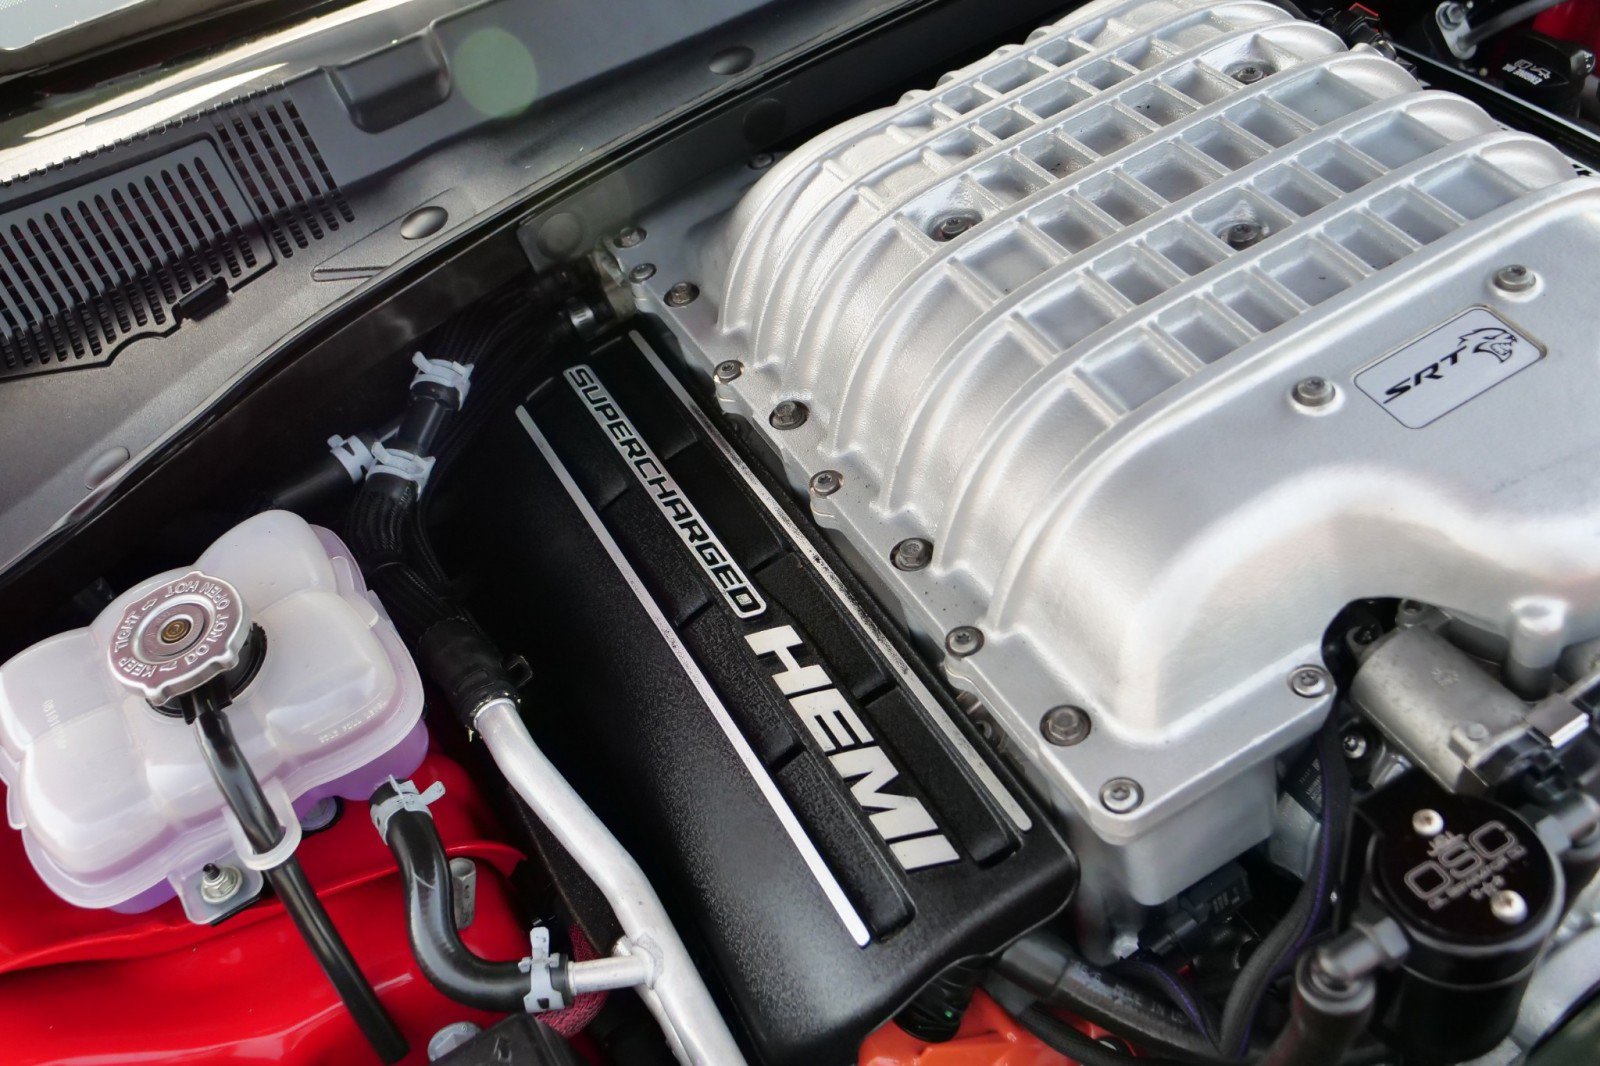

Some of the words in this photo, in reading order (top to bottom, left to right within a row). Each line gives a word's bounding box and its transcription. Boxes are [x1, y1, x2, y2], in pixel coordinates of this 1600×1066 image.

[1382, 344, 1468, 405] SRT
[568, 367, 762, 613] SUPERCHARGED
[164, 580, 200, 598] HOT
[199, 581, 231, 611] OPEN
[114, 610, 140, 654] TIGHT
[206, 613, 230, 643] NOT
[118, 656, 158, 678] KEEP
[184, 643, 210, 665] DO
[743, 624, 960, 872] HEMI
[1403, 819, 1519, 900] OSC
